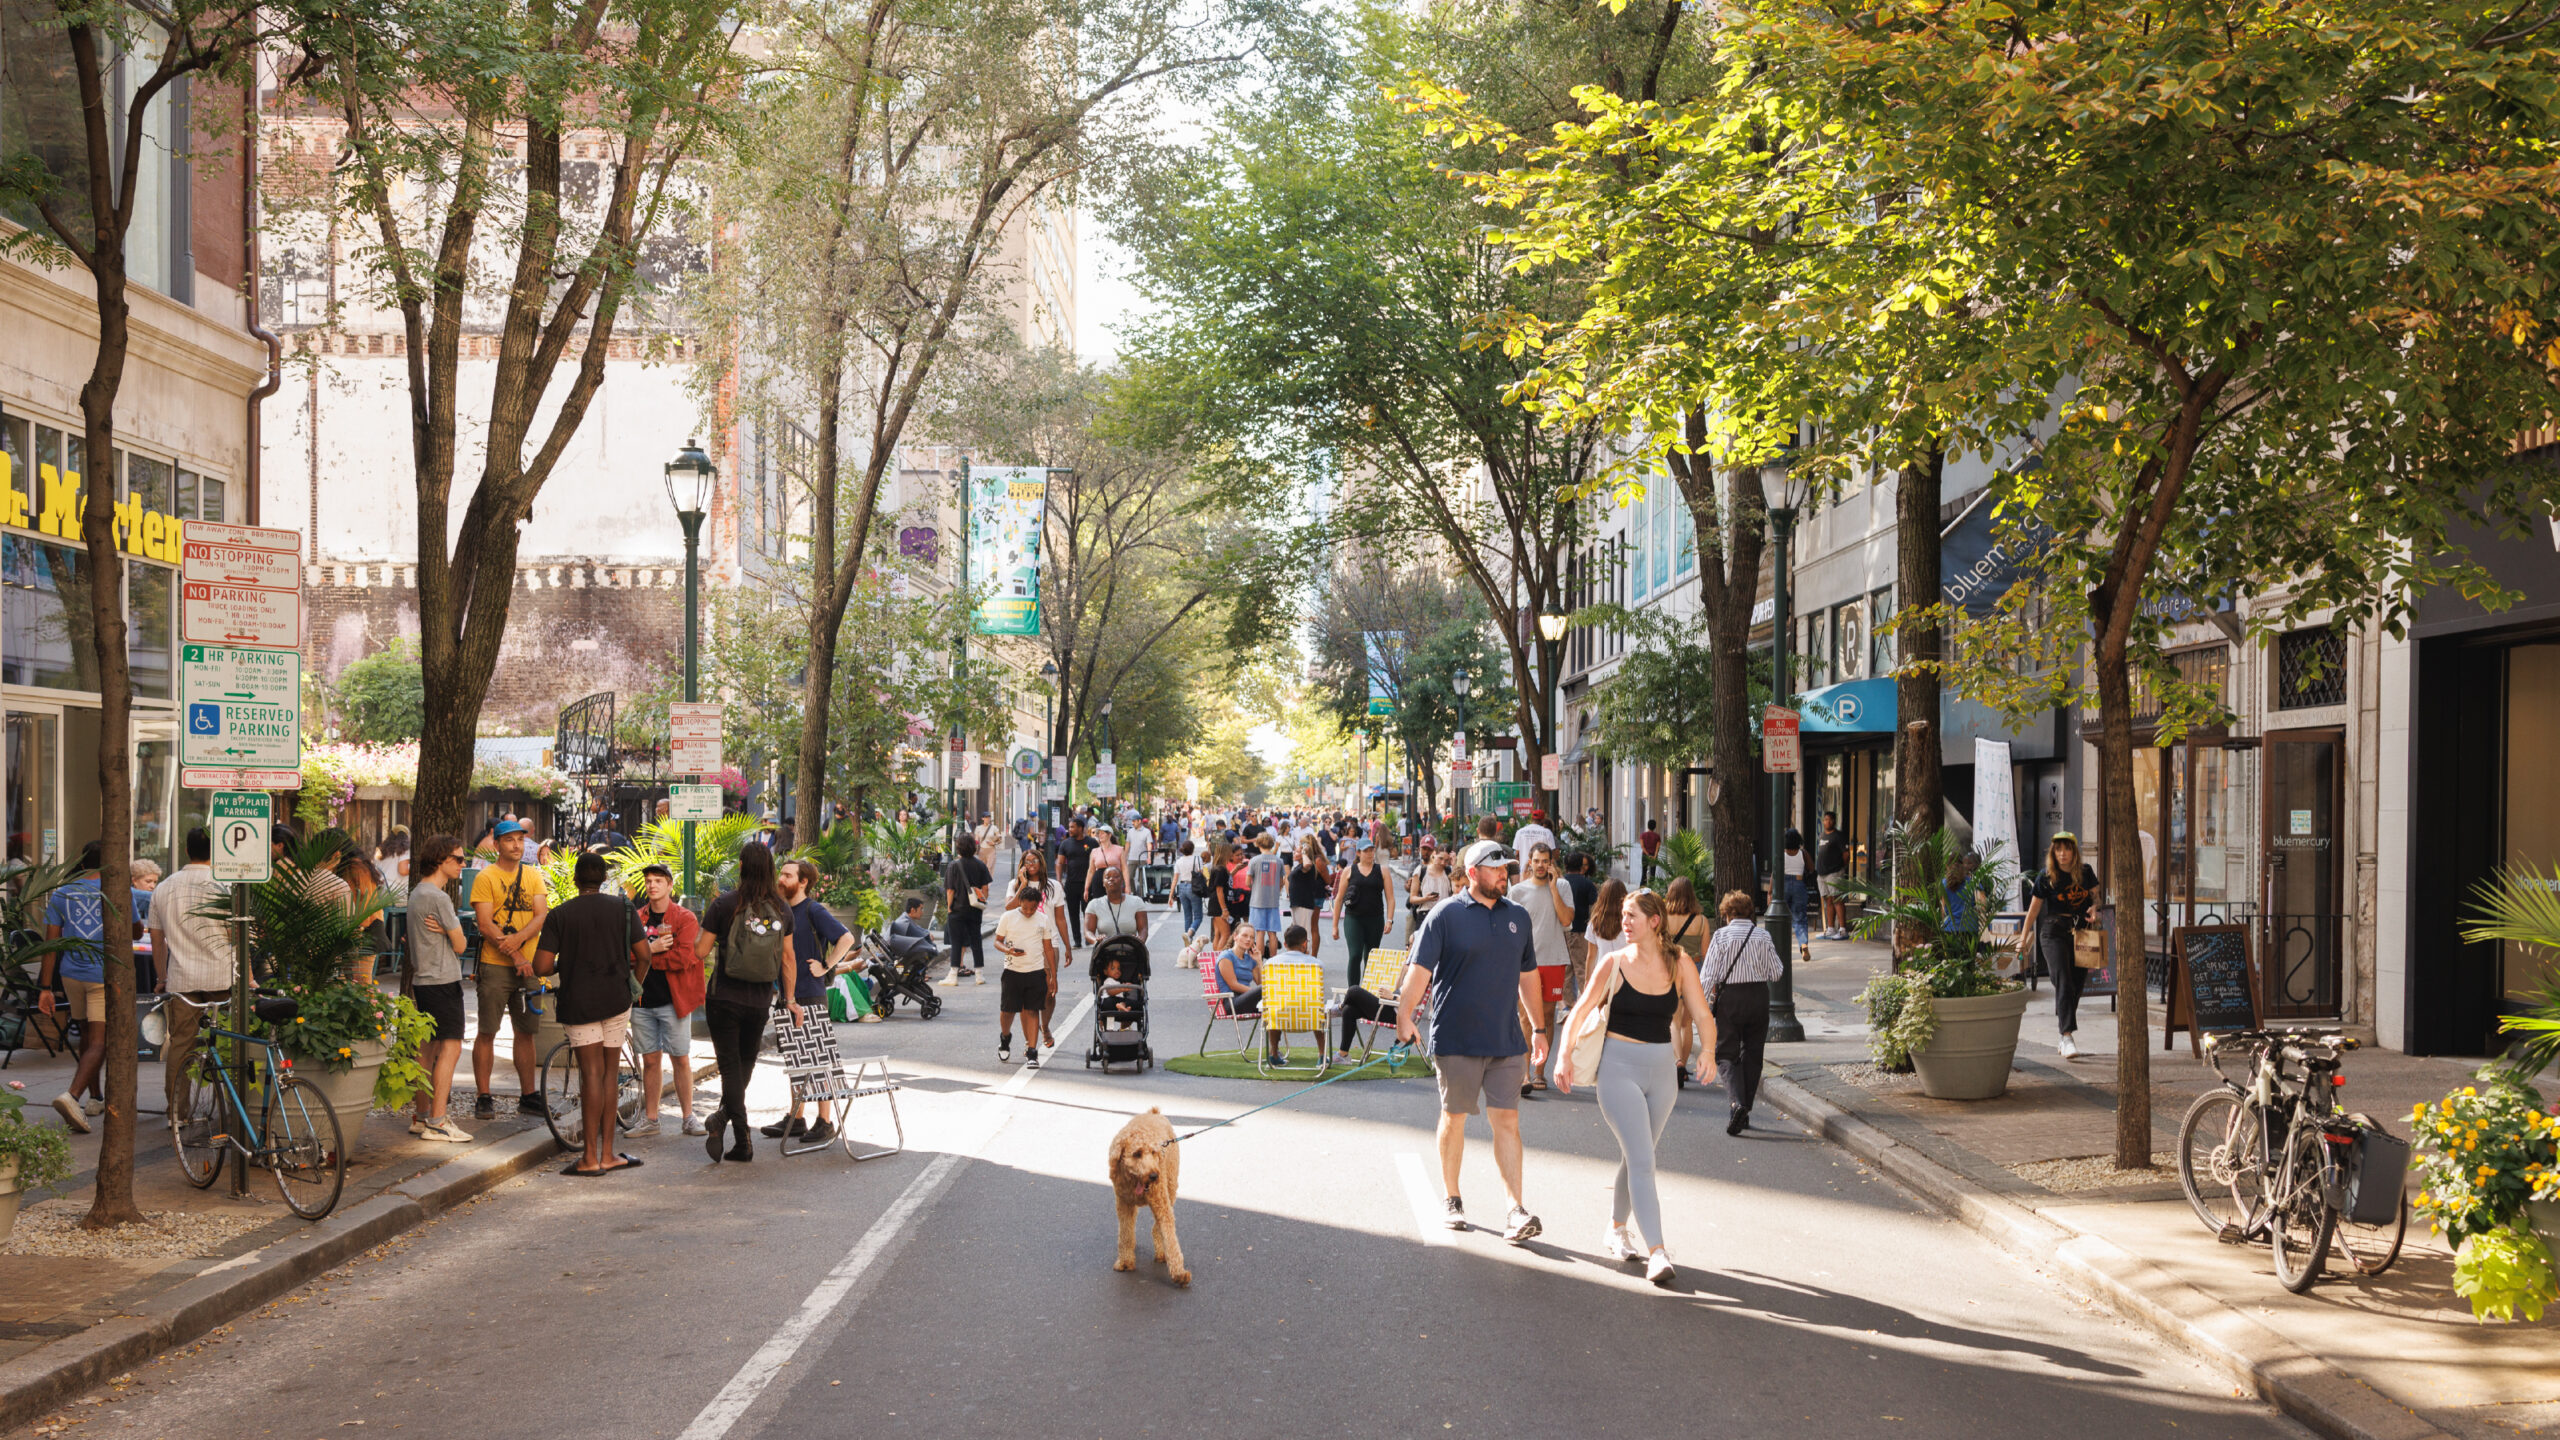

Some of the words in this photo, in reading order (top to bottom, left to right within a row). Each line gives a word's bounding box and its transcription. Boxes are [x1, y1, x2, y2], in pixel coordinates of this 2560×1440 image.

[40, 462, 182, 565] Mrten
[189, 545, 208, 558] NO
[214, 549, 274, 566] STOPPING
[200, 560, 226, 568] MON-FRI
[1972, 567, 2003, 597] makeup
[189, 586, 207, 598] NO
[213, 588, 266, 604] PARKING
[208, 602, 228, 610] TRUCK
[230, 604, 258, 612] LOADING
[2141, 598, 2180, 618] kincare
[198, 617, 224, 625] MON-FRI
[1846, 620, 1856, 662] R
[190, 648, 198, 660] 2
[208, 650, 224, 662] HR
[232, 651, 284, 666] PARKING
[194, 664, 220, 672] MON-FRI
[194, 680, 221, 688] SAT-SUN
[226, 706, 294, 722] RESERVED
[230, 722, 290, 737] PARKING
[1774, 738, 1790, 747] ANY
[1772, 750, 1792, 759] TIME
[214, 797, 229, 805] PAY
[246, 798, 269, 806] PLATE
[224, 808, 258, 816] PARKING
[2046, 812, 2062, 820] METRO
[234, 826, 246, 849] P
[2272, 835, 2330, 849] bluemercury
[2206, 960, 2228, 972] SPEND
[2194, 972, 2208, 982] GET
[2226, 971, 2239, 980] OFF
